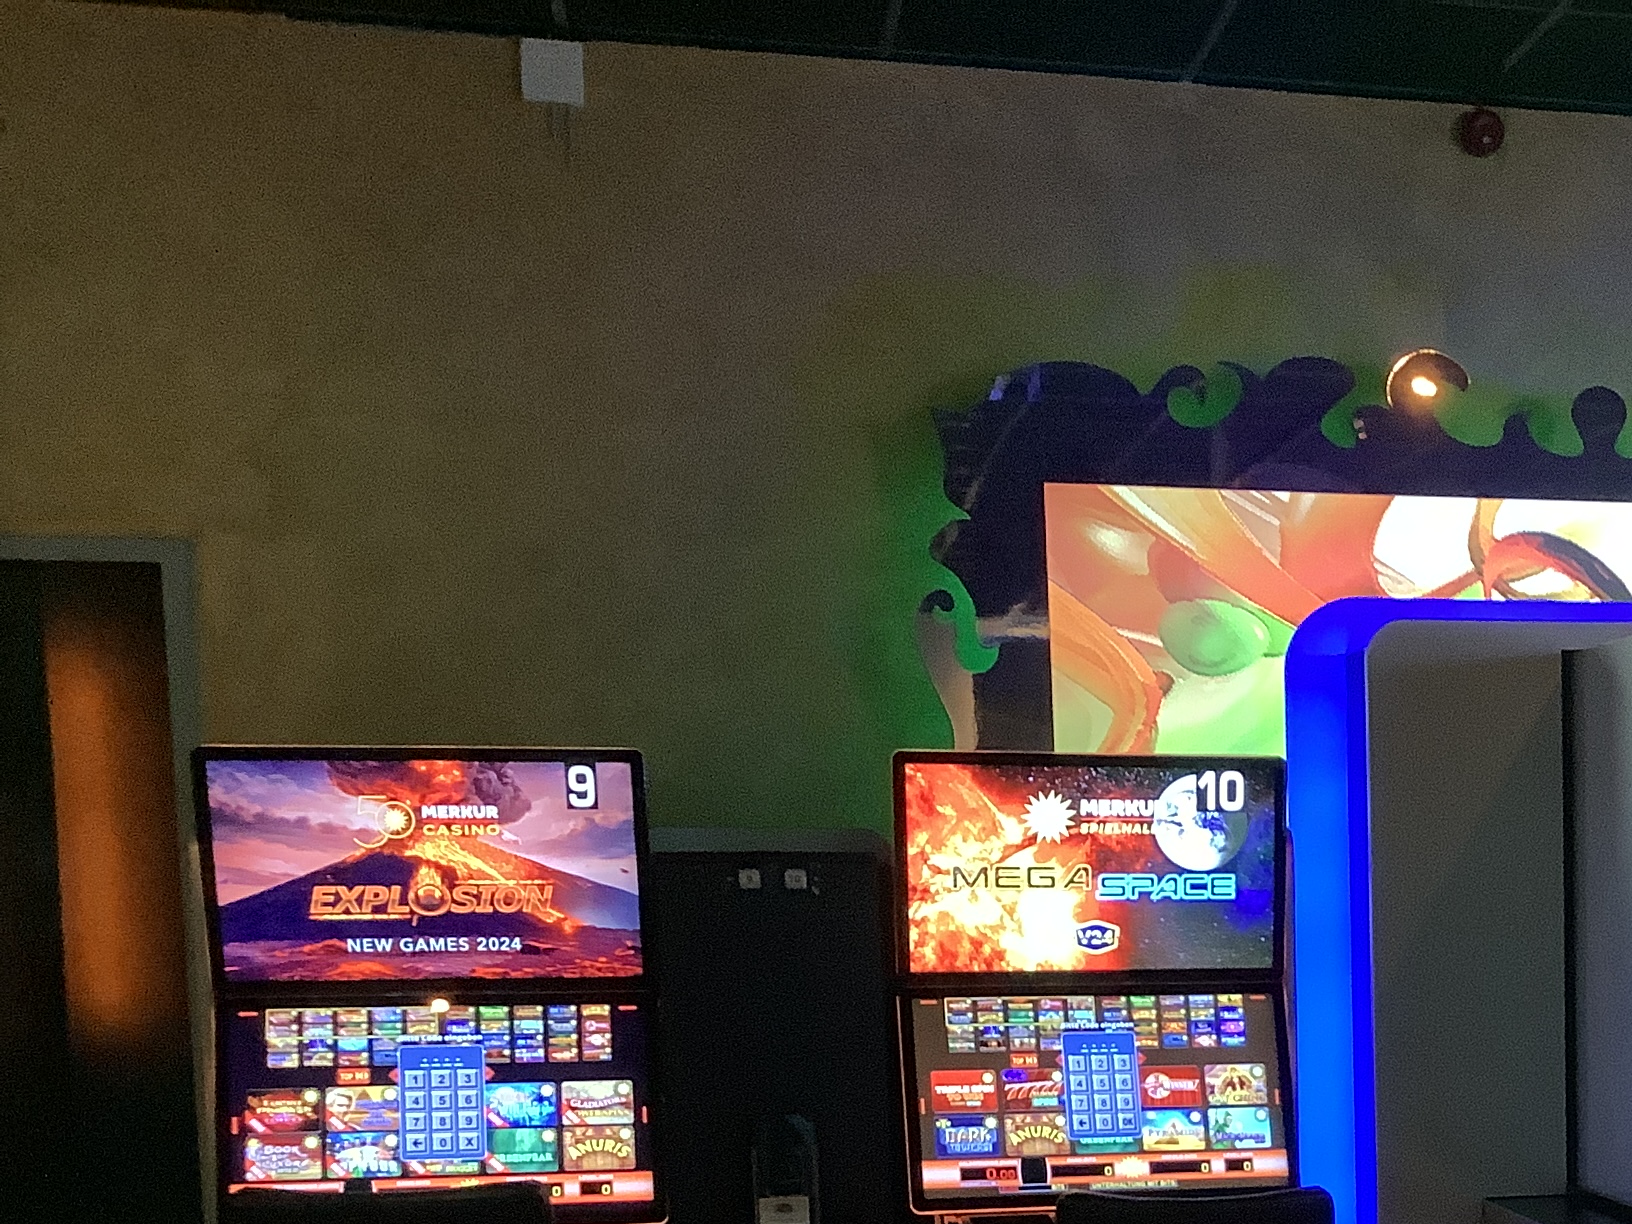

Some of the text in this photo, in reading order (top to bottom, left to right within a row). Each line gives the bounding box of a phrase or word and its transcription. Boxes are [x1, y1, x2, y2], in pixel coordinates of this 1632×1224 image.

[567, 765, 596, 808] 9
[1197, 770, 1245, 812] 10
[421, 804, 499, 819] MERKUR
[1080, 798, 1155, 817] MERKU
[422, 824, 501, 836] CASINO
[951, 864, 1093, 891] MEGA
[1096, 873, 1237, 902] SPACE
[309, 884, 554, 917] EXPLOSION
[347, 937, 523, 952] NEW GAMES 2024
[438, 1074, 445, 1084] 2
[464, 1074, 471, 1084] 3
[412, 1095, 472, 1106] 4 5 6
[412, 1116, 473, 1127] 7 8 9
[1008, 1125, 1067, 1146] ANURIS
[439, 1138, 447, 1148] 0
[567, 1139, 632, 1161] ANURIS
[1104, 1166, 1113, 1176] 0
[1200, 1162, 1209, 1173] 0
[1243, 1161, 1251, 1171] 0
[986, 1167, 1016, 1180] 0.00
[552, 1186, 562, 1196] 0
[601, 1184, 611, 1195] 0
